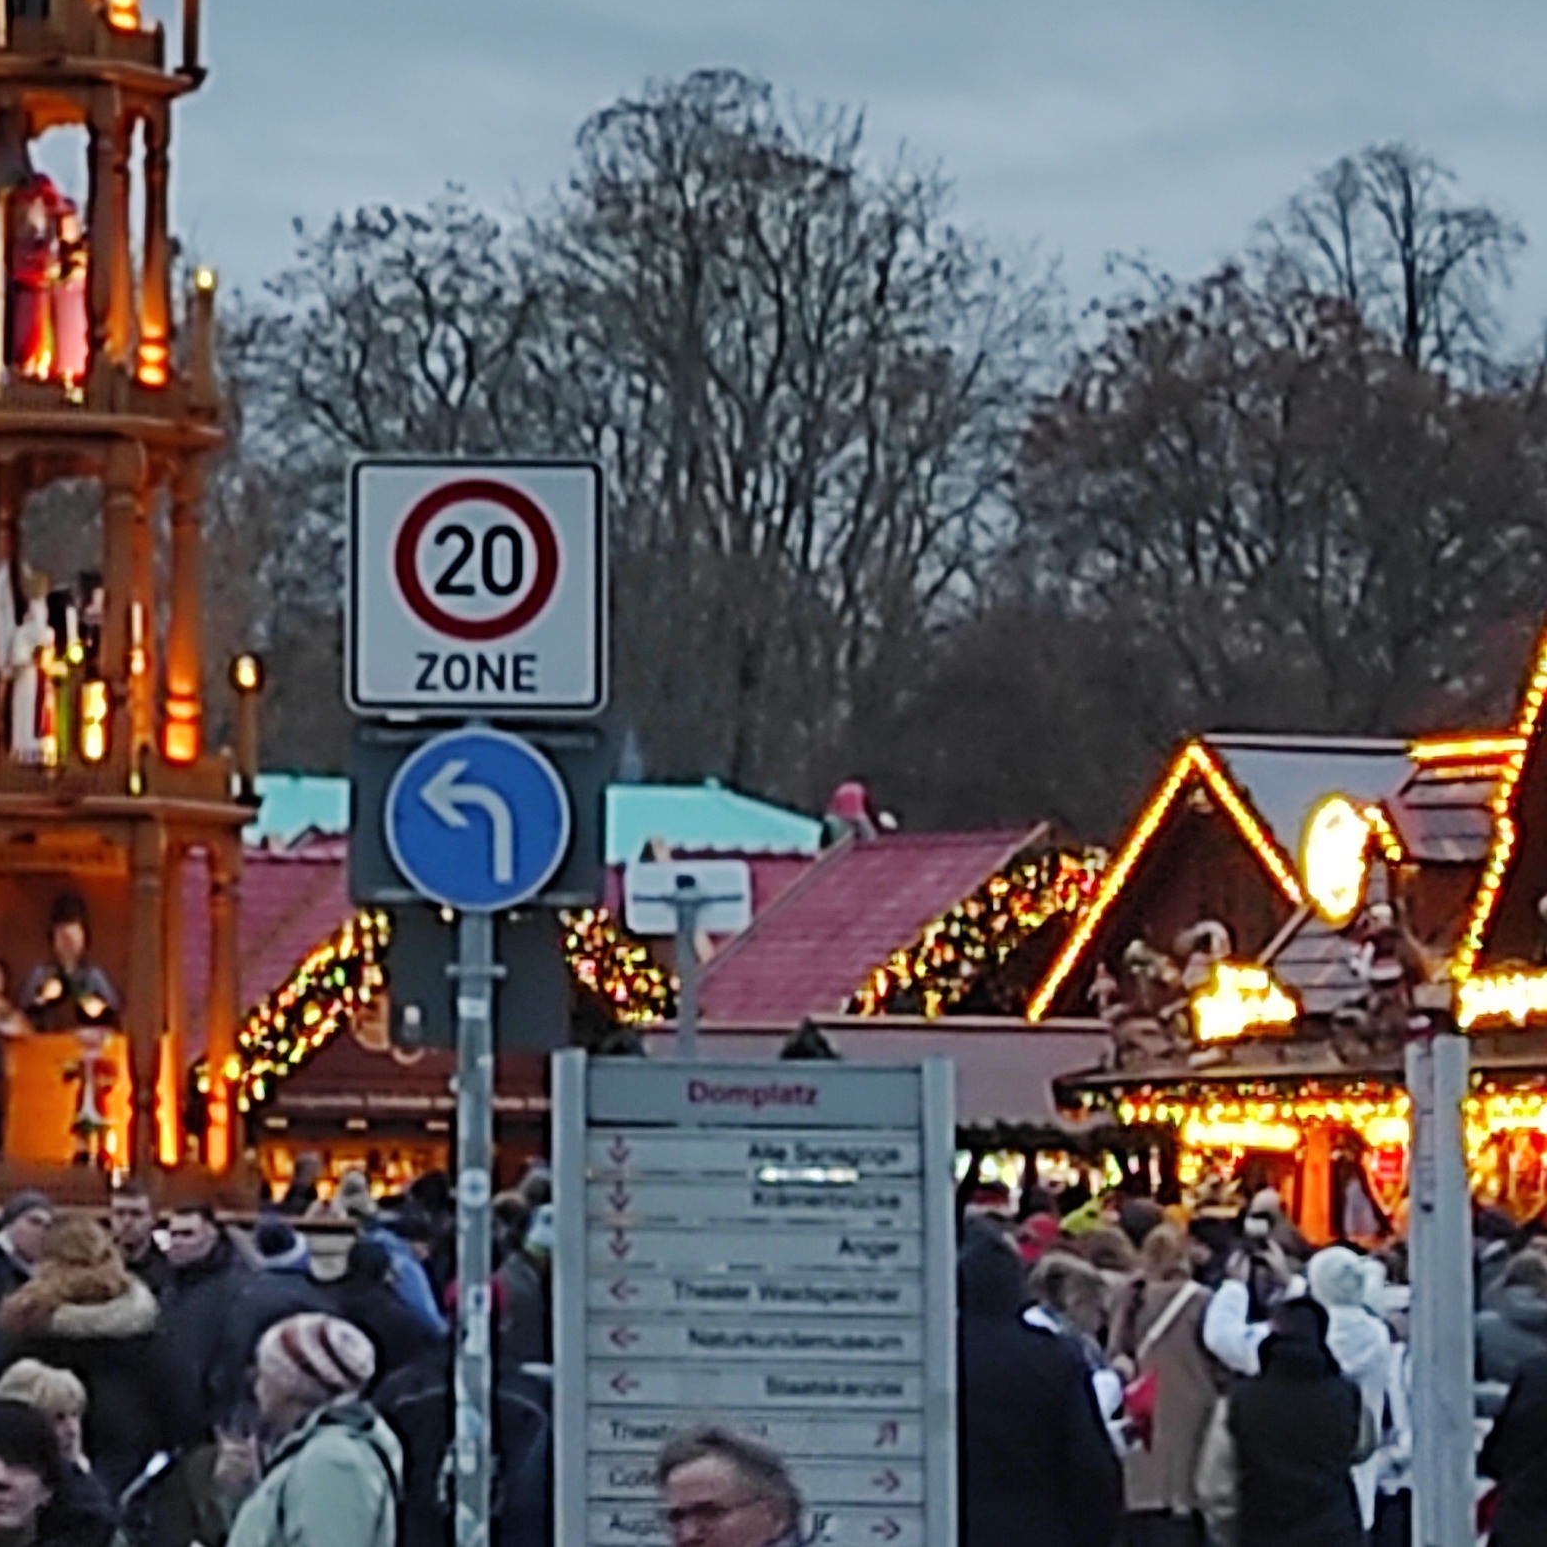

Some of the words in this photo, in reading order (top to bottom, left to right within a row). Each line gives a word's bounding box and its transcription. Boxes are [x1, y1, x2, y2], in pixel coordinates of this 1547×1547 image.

[433, 524, 524, 597] 20
[414, 653, 539, 693] ZONE
[687, 1080, 820, 1109] Domplatz
[747, 1142, 788, 1160] Alte
[793, 1143, 901, 1166] Synagoge
[752, 1190, 901, 1209] Krämerbrücke
[837, 1236, 900, 1261] Anger
[672, 1279, 751, 1301] Theater
[758, 1282, 900, 1305] Waidspeicher
[687, 1328, 904, 1351] Naturkundemuseum
[764, 1375, 904, 1397] Staatskanzlei
